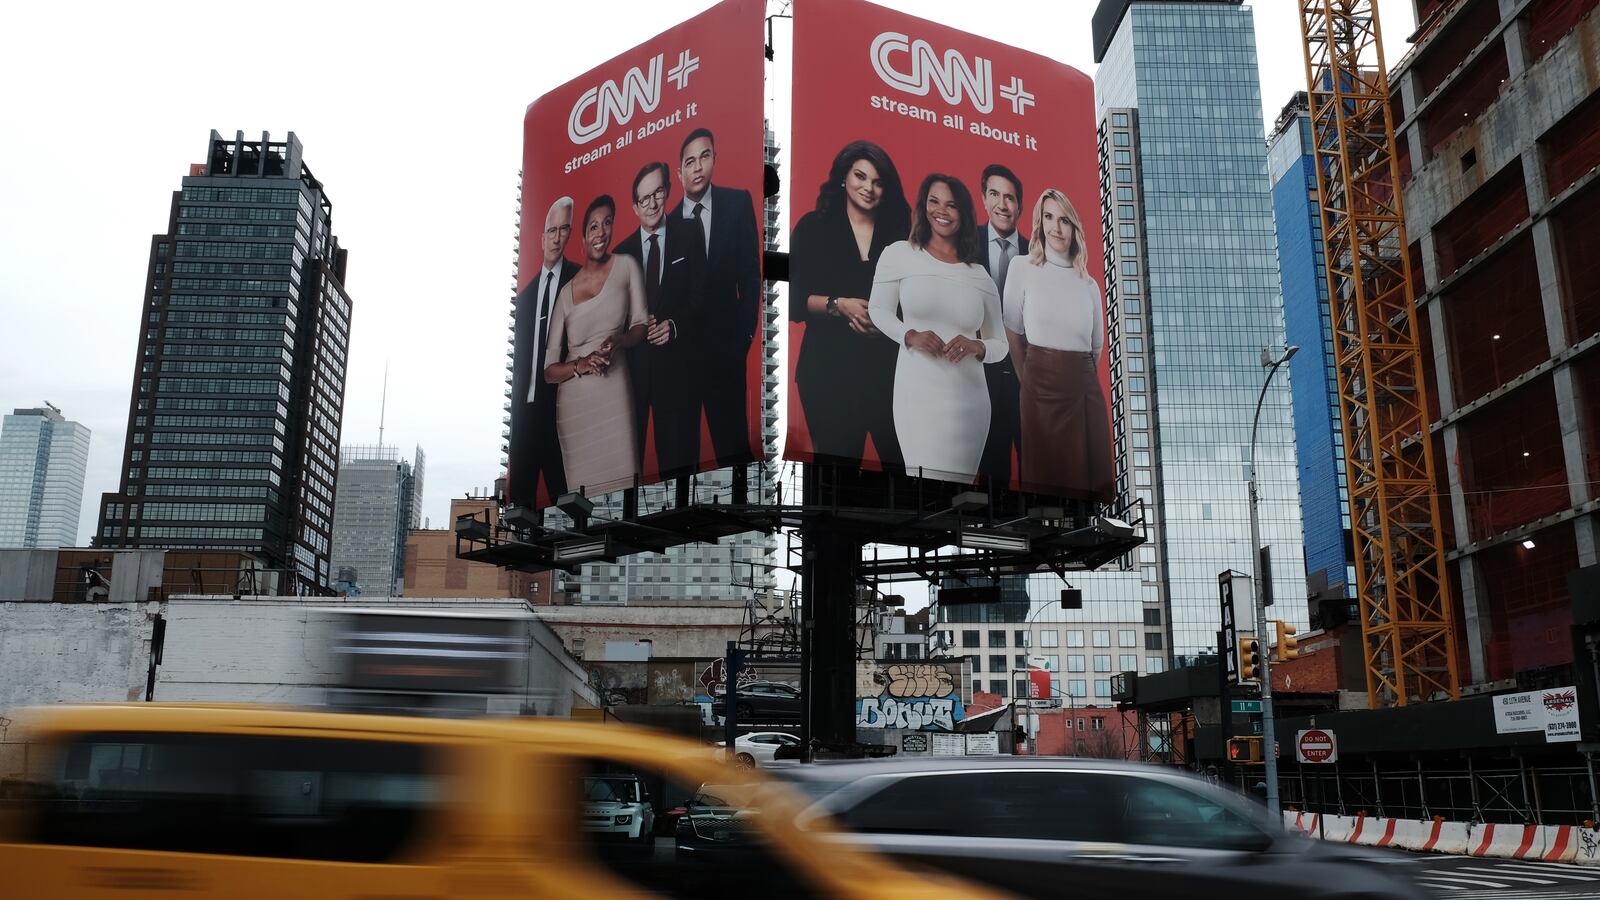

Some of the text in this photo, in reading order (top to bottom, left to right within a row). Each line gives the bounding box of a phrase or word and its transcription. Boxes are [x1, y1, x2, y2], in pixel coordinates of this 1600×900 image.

[565, 102, 697, 173] stream all about it
[870, 95, 1037, 151] stream all about it
[1222, 583, 1235, 672] PARK
[1240, 702, 1246, 711] 11
[1545, 697, 1573, 705] ARSENAL
